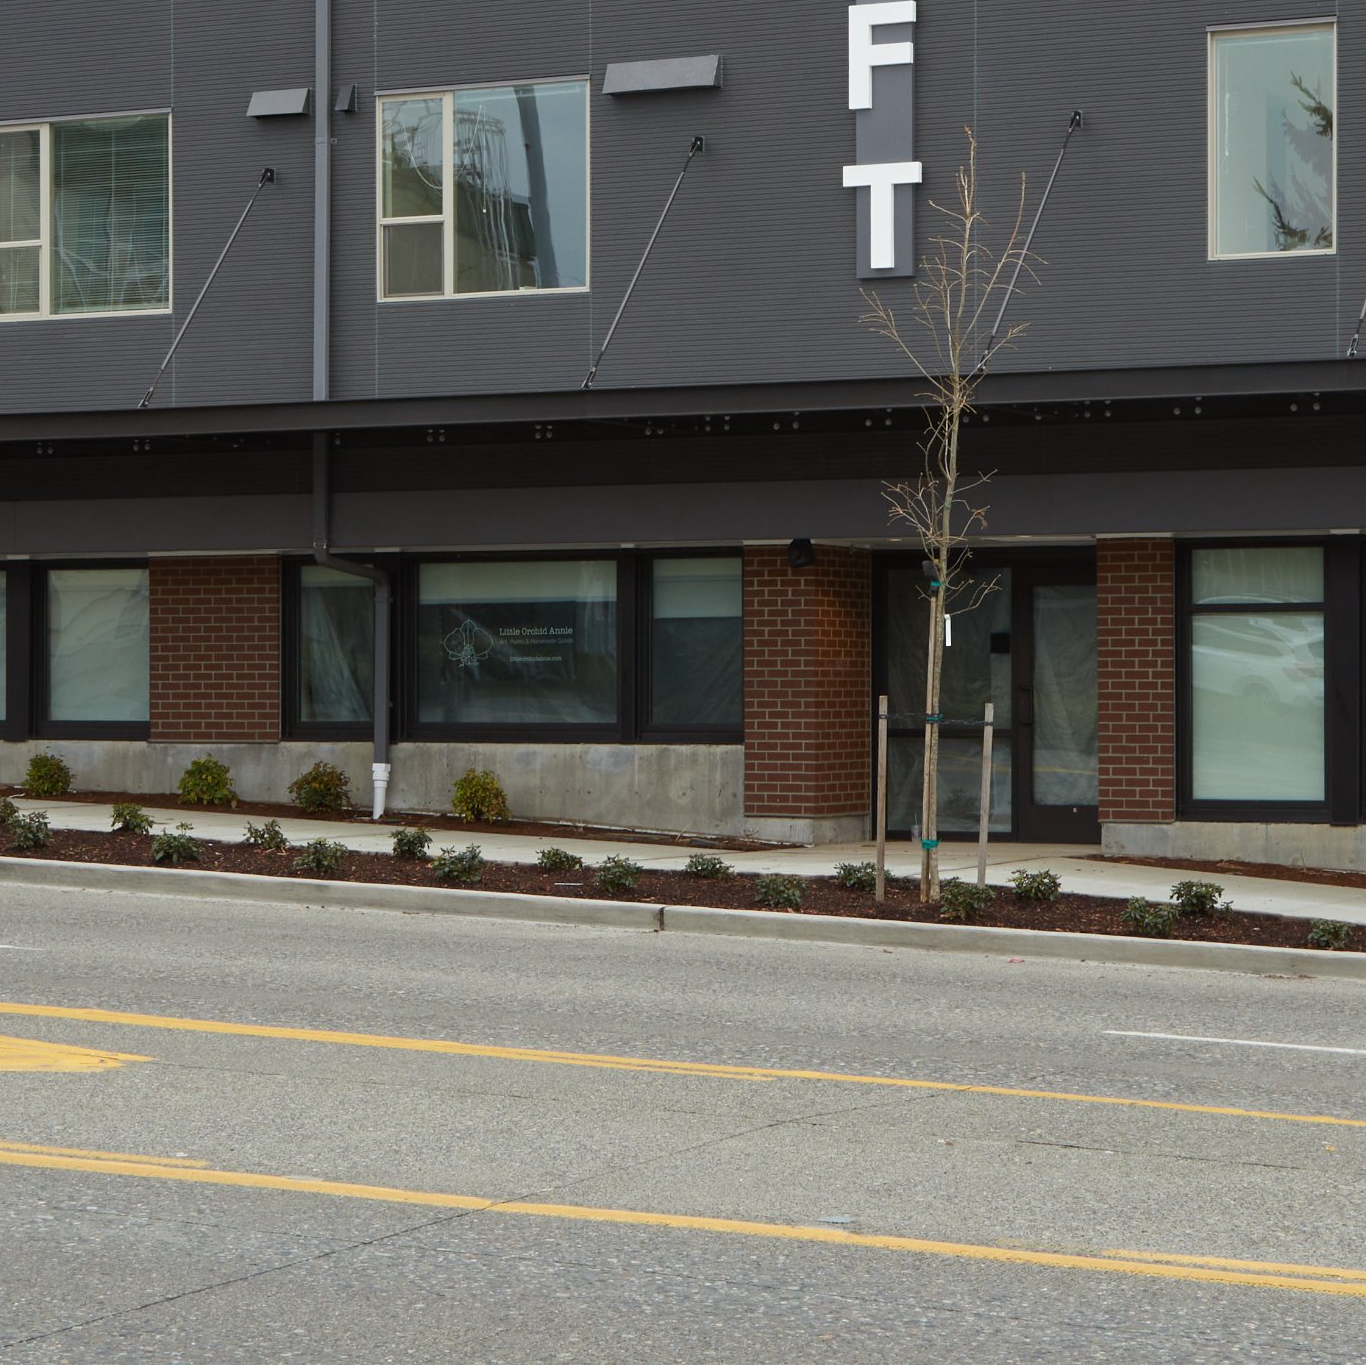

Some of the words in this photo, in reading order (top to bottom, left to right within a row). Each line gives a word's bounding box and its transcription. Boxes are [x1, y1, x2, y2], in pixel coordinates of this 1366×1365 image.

[499, 627, 521, 636] Little
[521, 626, 548, 635] Orchid
[549, 626, 573, 635] Annie
